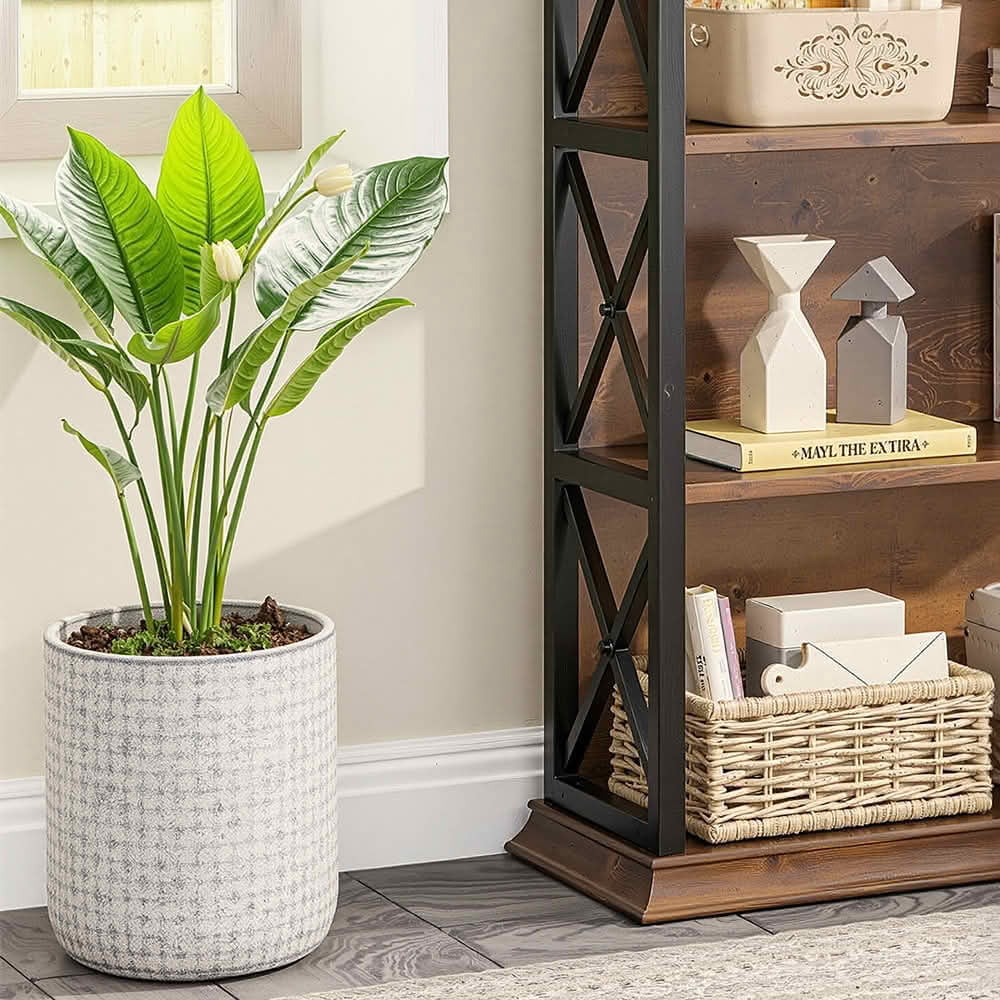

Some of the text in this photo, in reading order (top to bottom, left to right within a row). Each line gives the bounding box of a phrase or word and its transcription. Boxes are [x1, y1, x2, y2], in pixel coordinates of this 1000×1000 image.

[800, 438, 921, 460] MAYL THE EXTIRA
